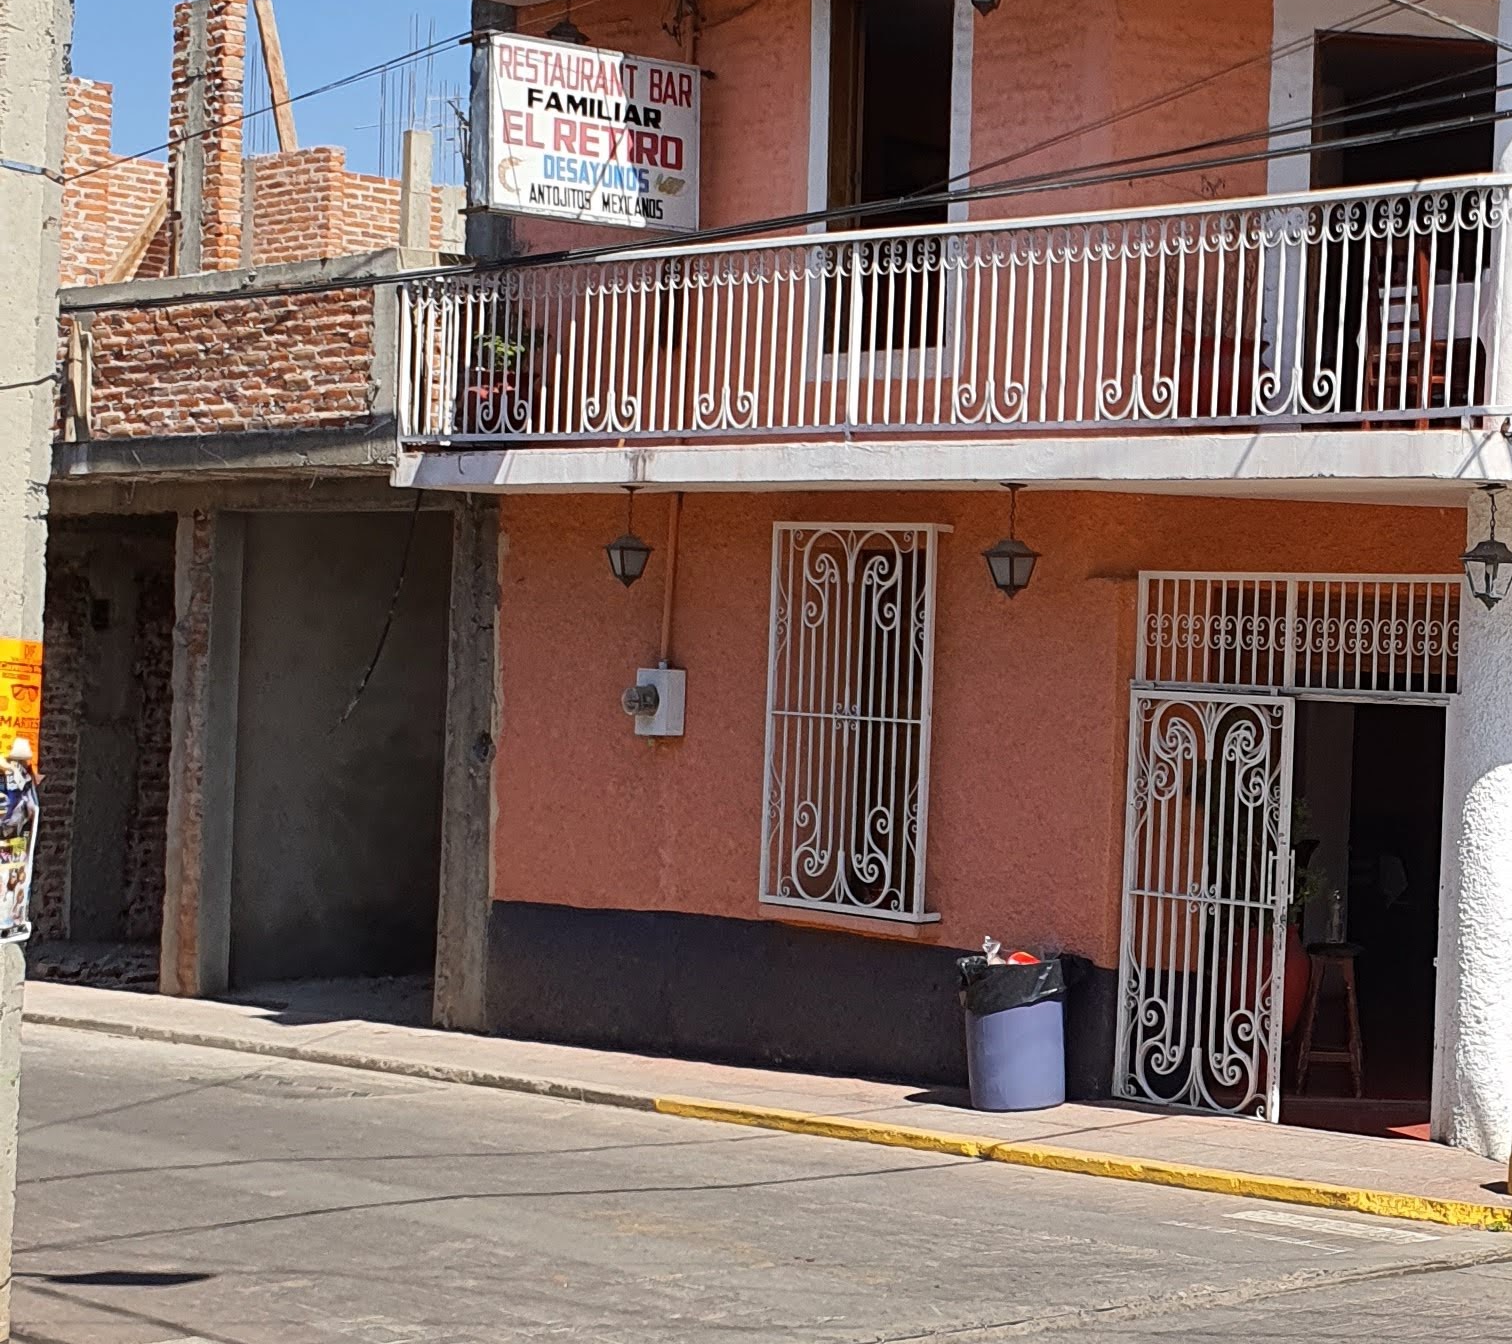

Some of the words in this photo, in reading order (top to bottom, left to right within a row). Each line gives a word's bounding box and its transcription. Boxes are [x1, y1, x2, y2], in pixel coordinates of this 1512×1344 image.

[500, 44, 638, 99] RESTAURANT
[649, 68, 692, 108] BAR
[527, 88, 662, 129] FAMILIAR
[503, 110, 545, 150] EL
[553, 117, 684, 171] RETIRO
[543, 154, 650, 193] DESAYUNOS
[529, 183, 591, 211] ANTOJITOS
[602, 192, 664, 219] MEXICANOS
